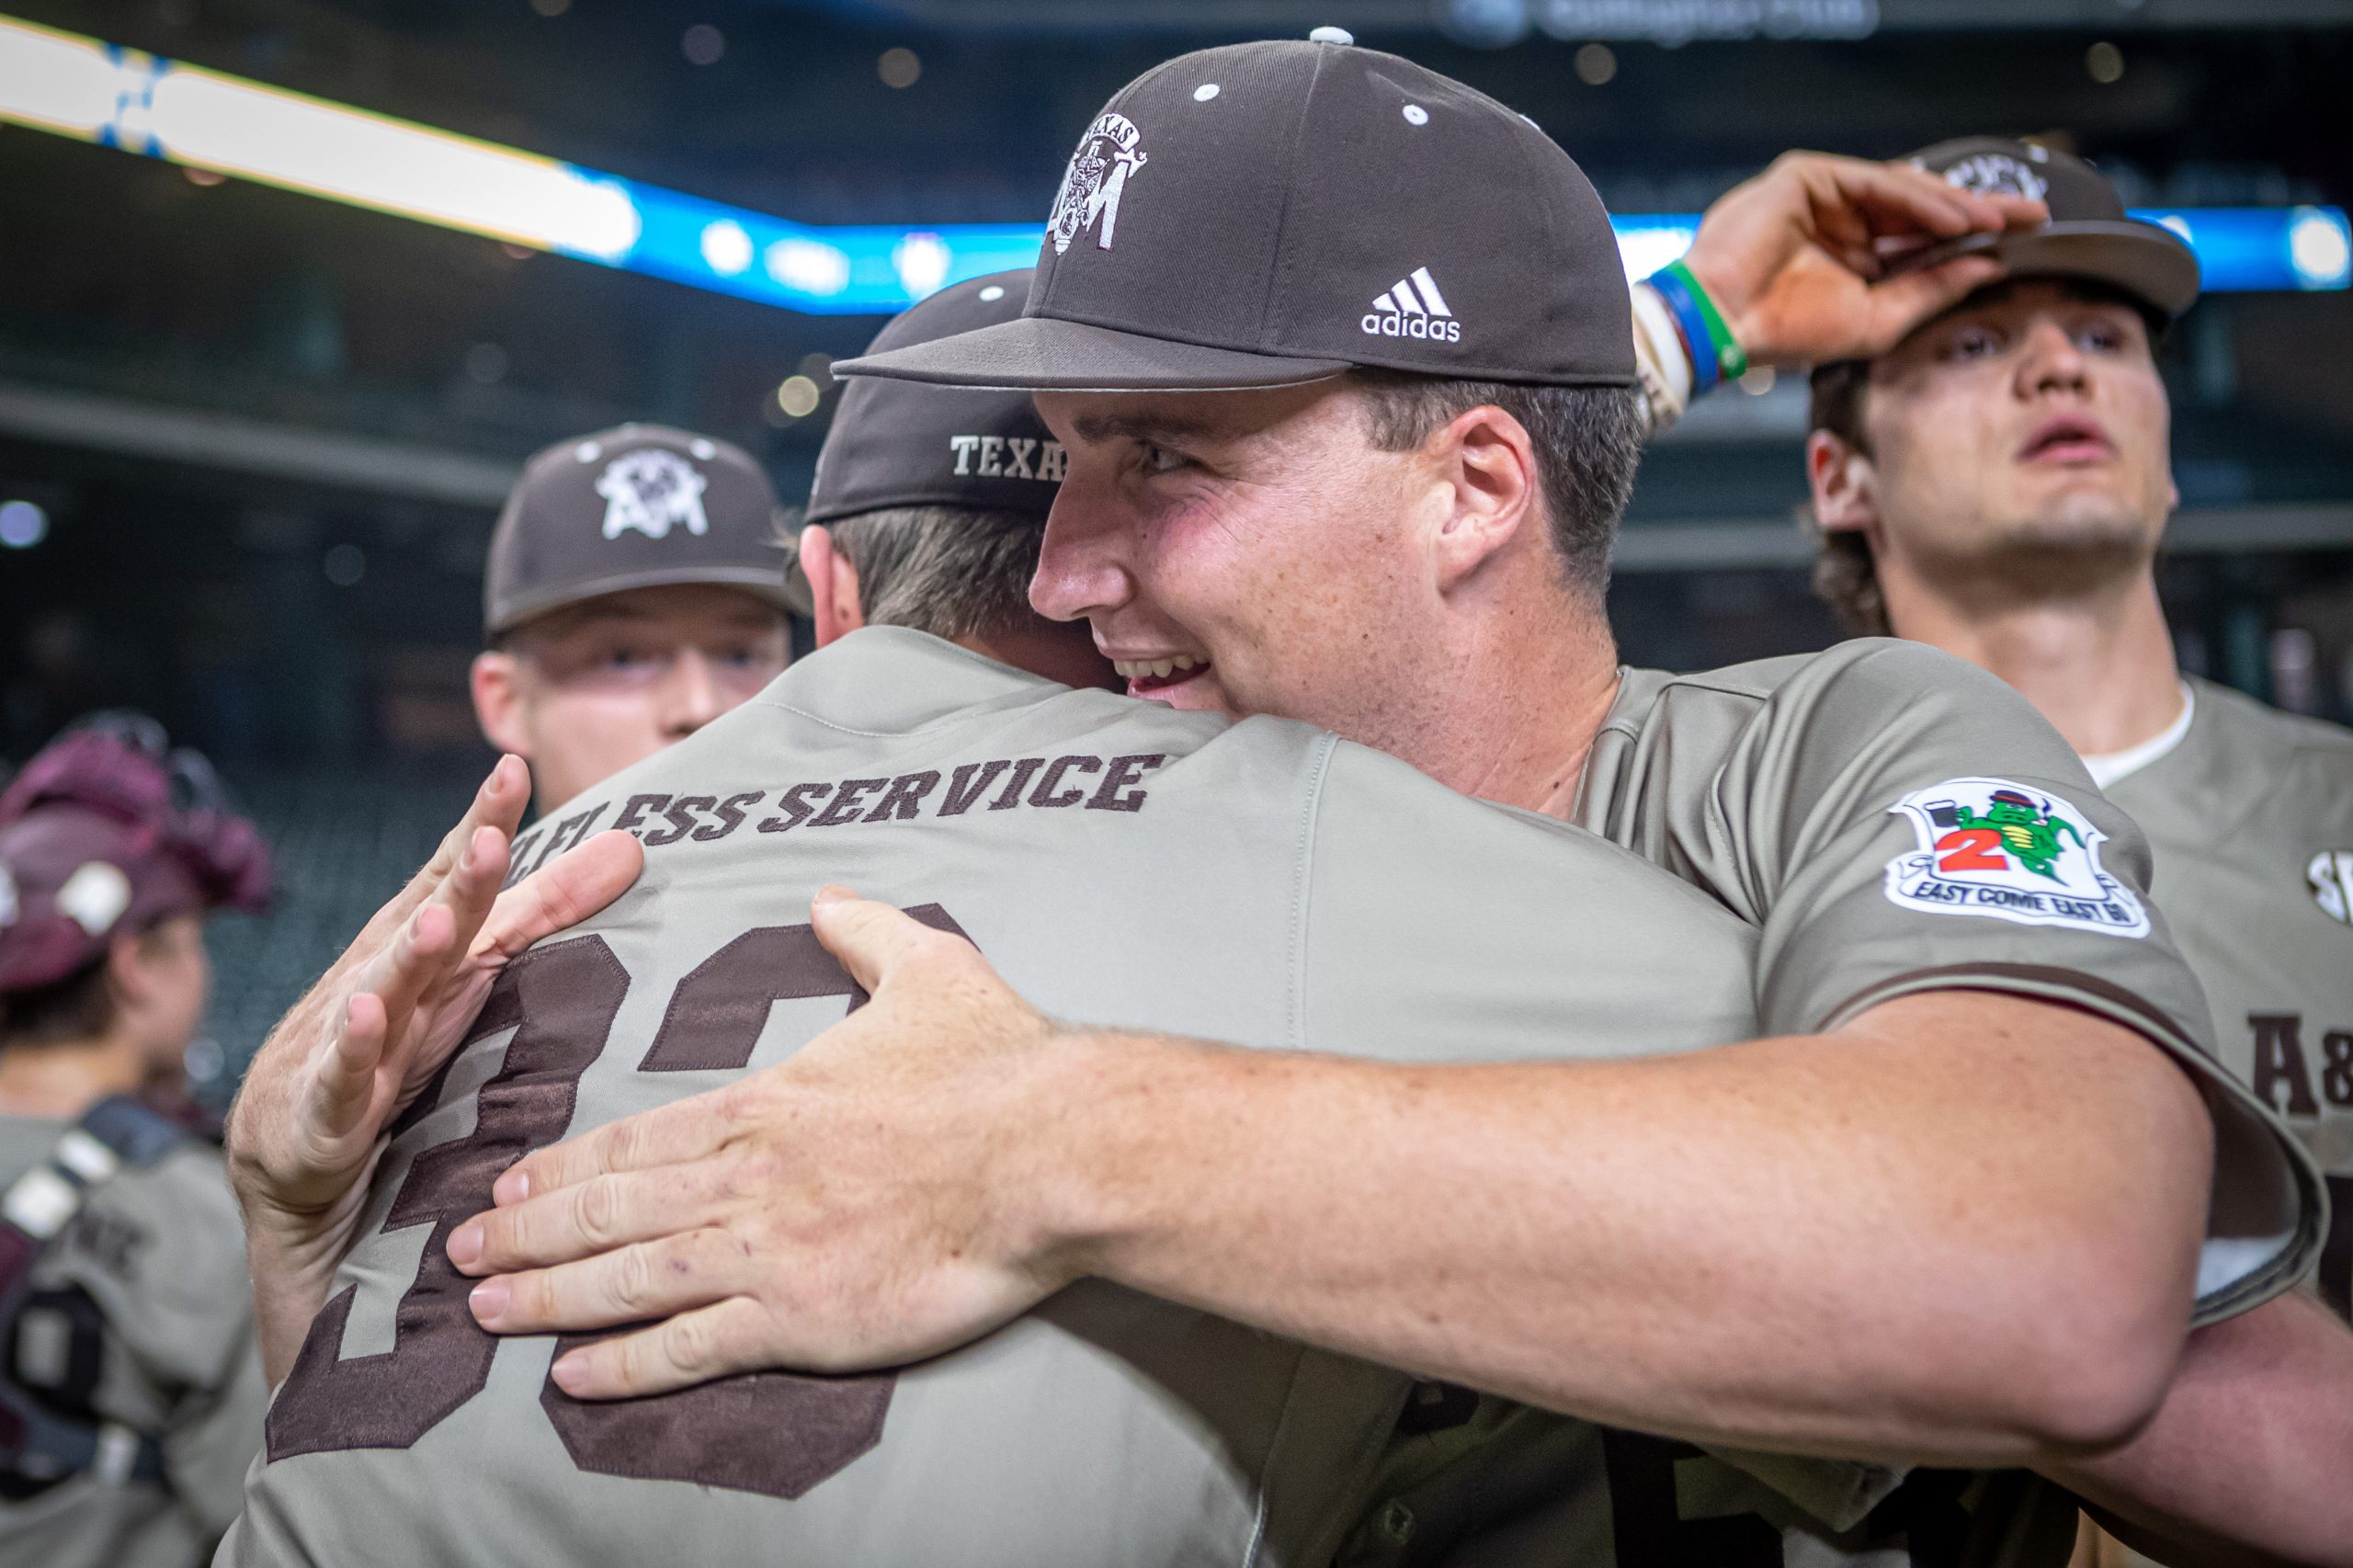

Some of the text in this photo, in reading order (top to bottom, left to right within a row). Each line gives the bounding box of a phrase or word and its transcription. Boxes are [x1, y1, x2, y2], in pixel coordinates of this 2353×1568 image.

[1361, 310, 1461, 343] adidas
[950, 435, 1068, 482] TEXA
[757, 754, 1166, 834] SERVICE
[1935, 828, 2010, 872] 2
[1978, 888, 2047, 911] COME
